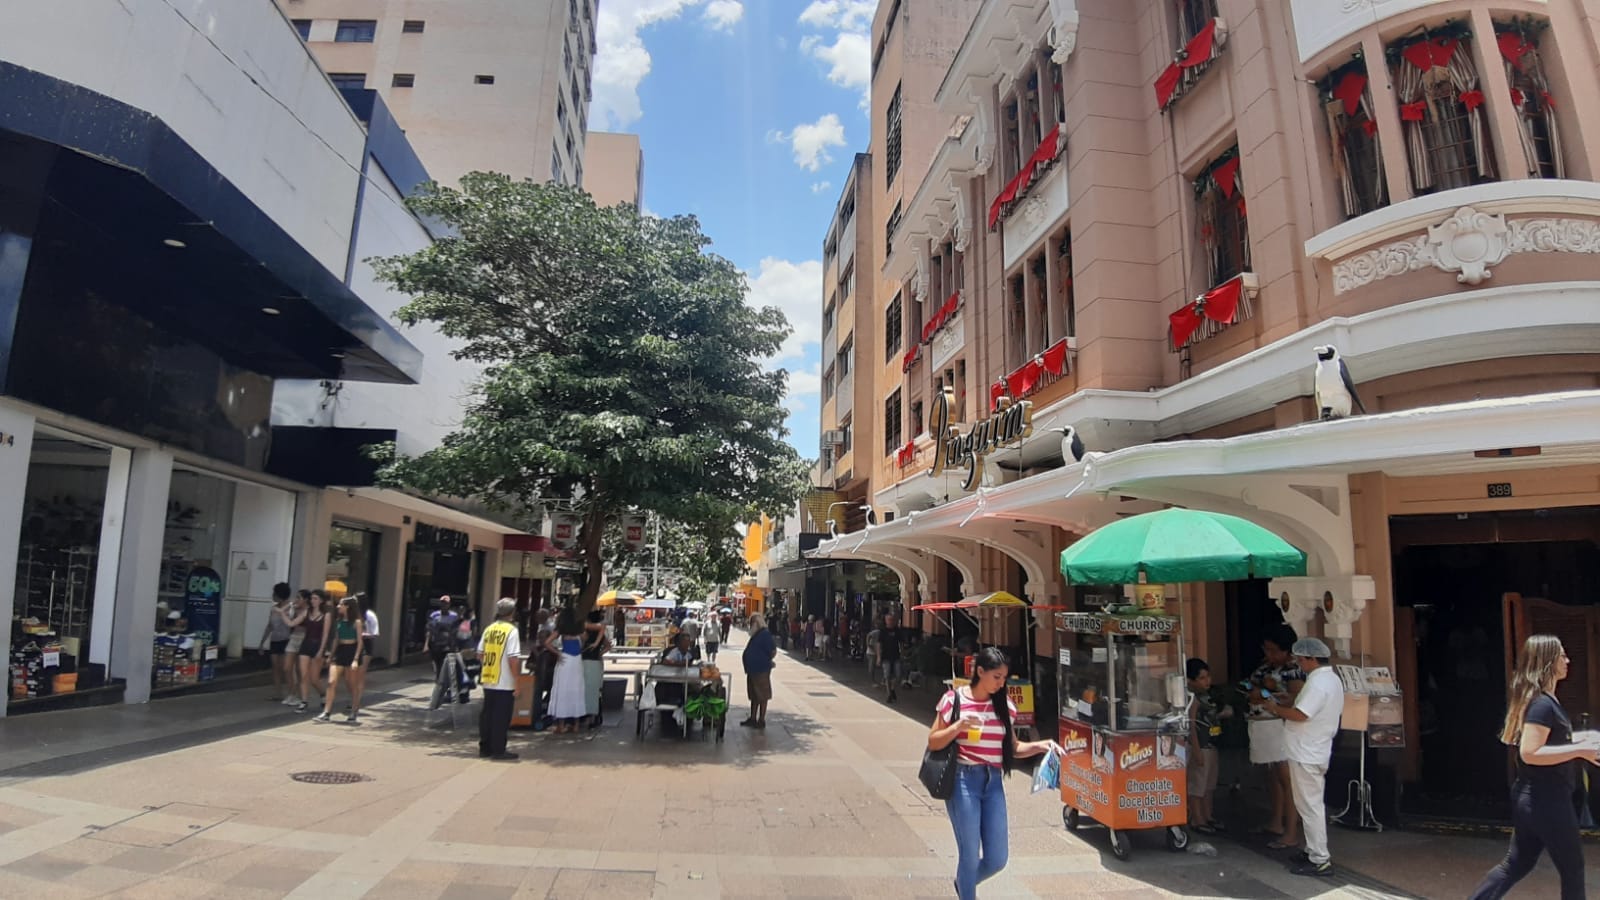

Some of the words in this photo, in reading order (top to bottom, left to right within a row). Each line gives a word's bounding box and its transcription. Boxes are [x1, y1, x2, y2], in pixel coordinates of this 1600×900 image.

[1489, 484, 1511, 497] 389
[1064, 616, 1101, 630] CHURROS
[1119, 620, 1172, 631] CHURROS
[1120, 745, 1153, 769] Churros
[1126, 778, 1172, 793] Chocolate
[1119, 795, 1142, 808] Doce
[1144, 794, 1156, 806] de
[1158, 792, 1180, 805] Leite
[1137, 809, 1163, 823] Misto
